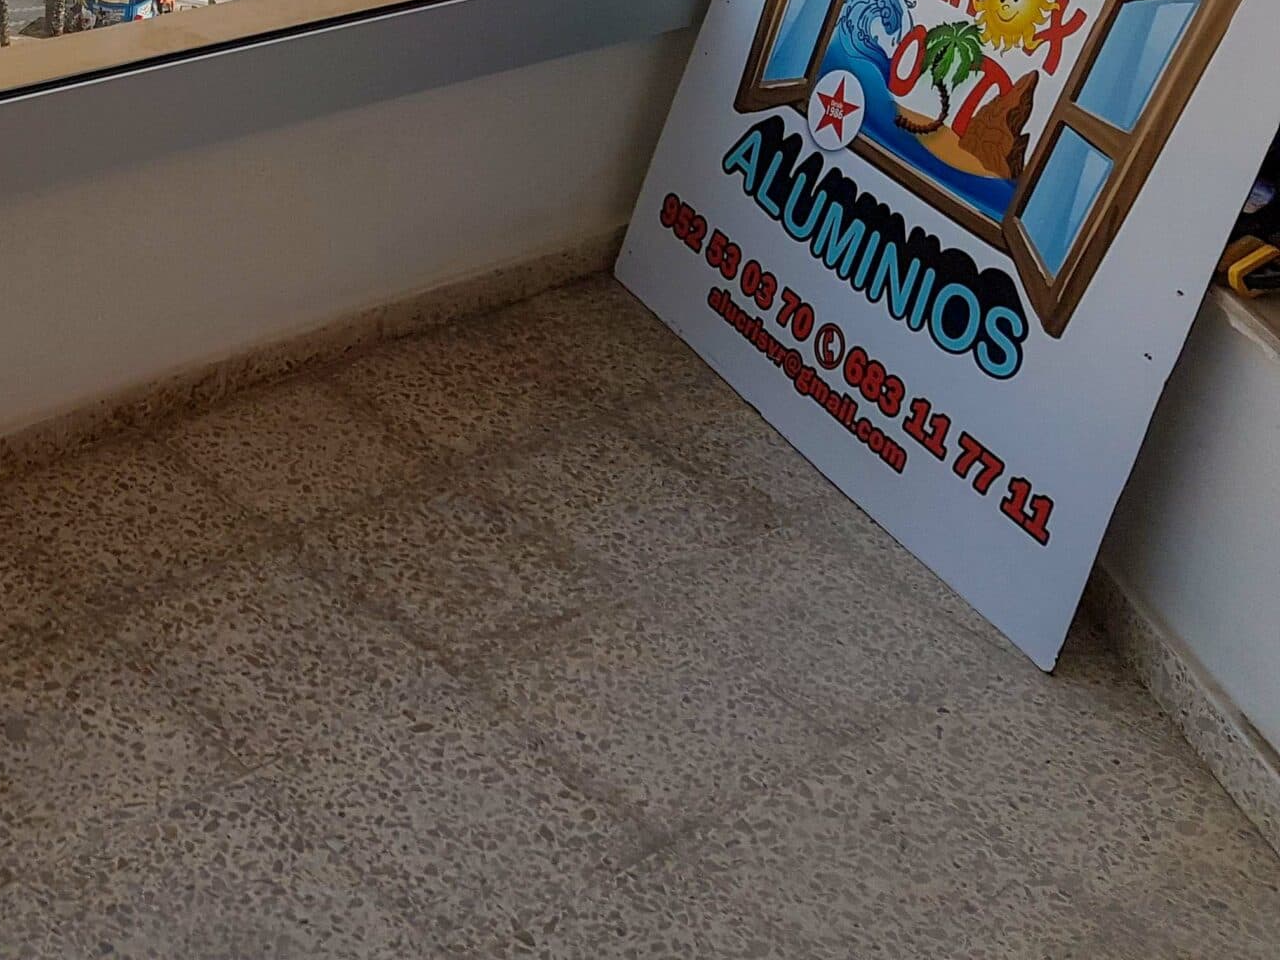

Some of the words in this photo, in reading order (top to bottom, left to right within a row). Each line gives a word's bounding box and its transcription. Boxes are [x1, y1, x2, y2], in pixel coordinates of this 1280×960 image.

[826, 105, 844, 119] 1986
[661, 193, 707, 253] 952
[706, 229, 741, 279] 53
[742, 260, 777, 310] 03
[776, 287, 814, 340] 70
[844, 347, 905, 417] 683
[903, 399, 951, 460] 11
[953, 432, 1004, 495] 77
[1000, 478, 1054, 546] 11
[724, 128, 1027, 379] ALUMINIOS
